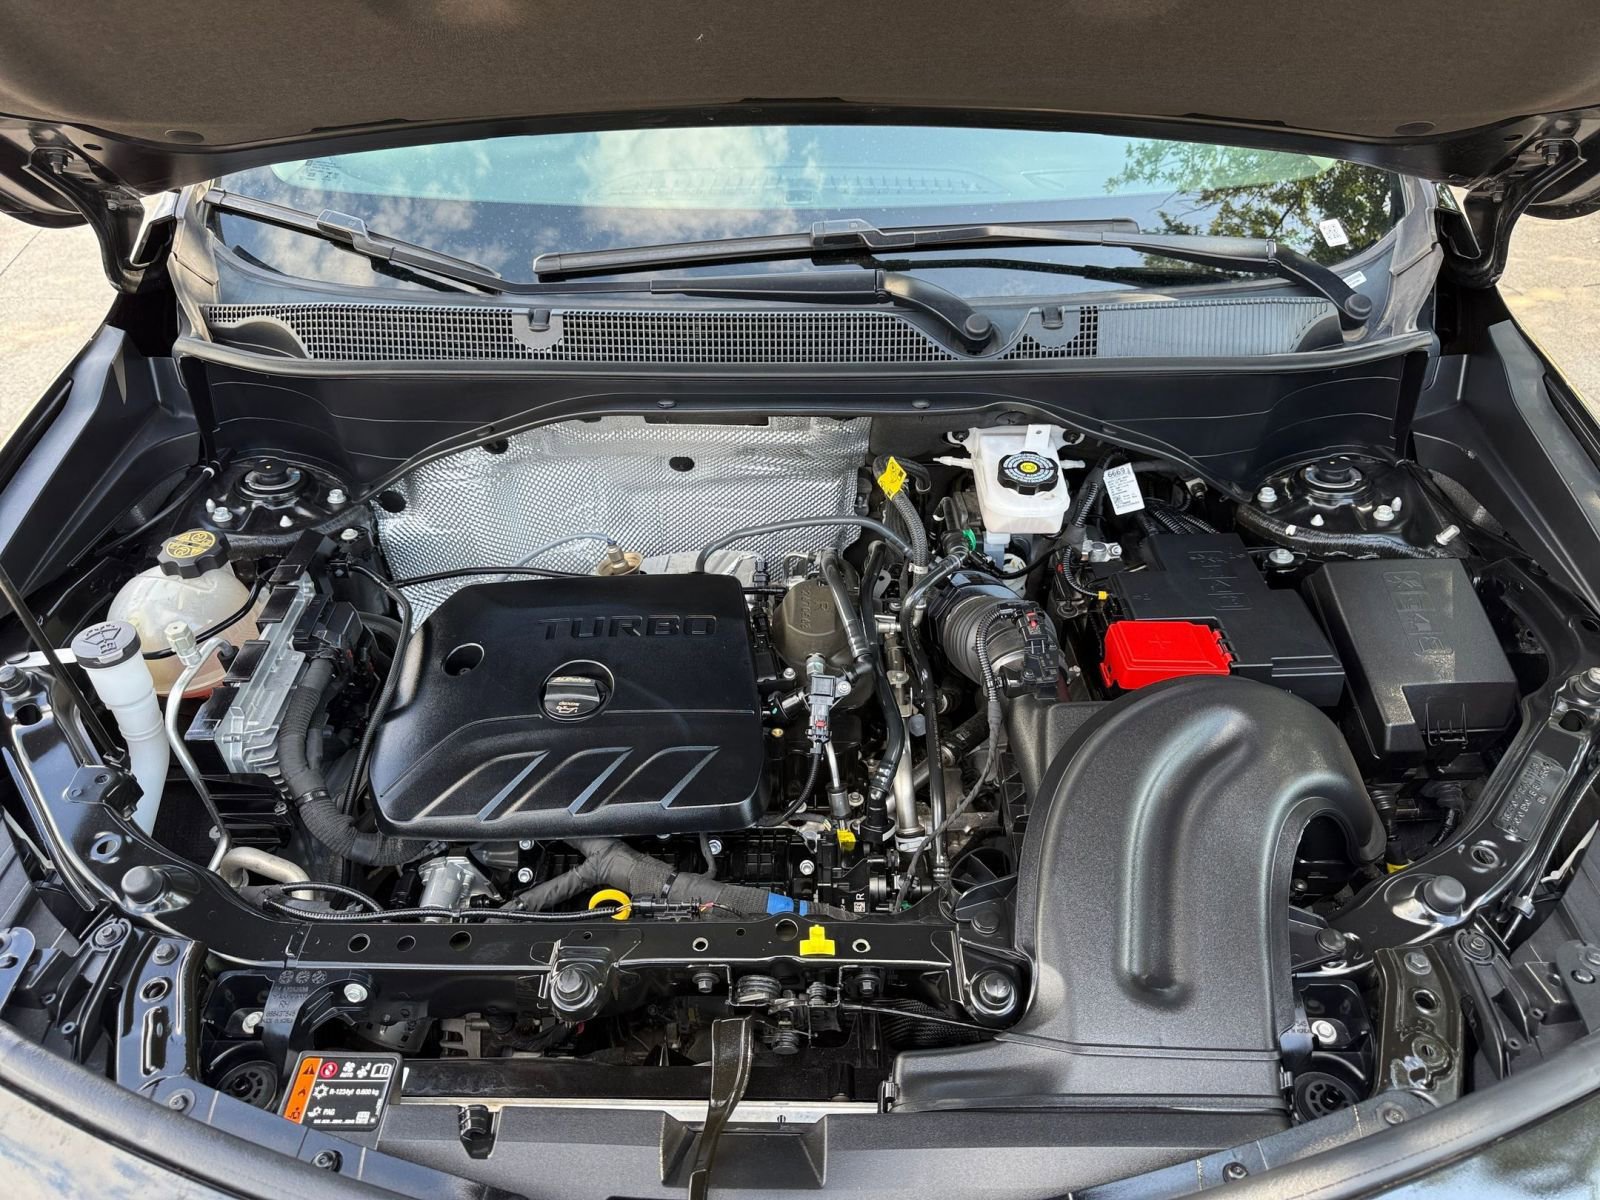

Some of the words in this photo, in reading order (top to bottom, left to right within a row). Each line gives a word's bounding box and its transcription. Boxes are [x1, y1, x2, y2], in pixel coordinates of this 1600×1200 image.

[538, 614, 717, 641] TURBO
[329, 1088, 355, 1096] R-1234yf
[322, 1108, 336, 1116] PAG
